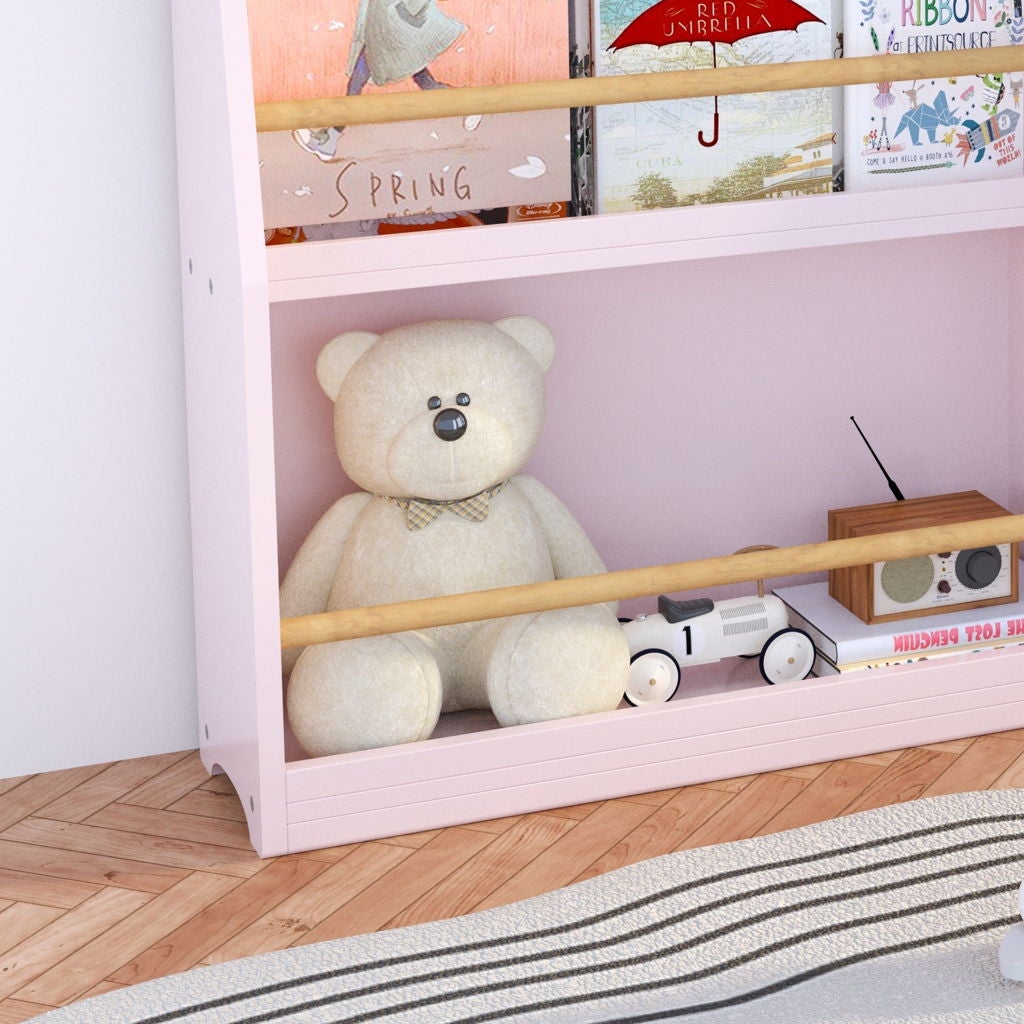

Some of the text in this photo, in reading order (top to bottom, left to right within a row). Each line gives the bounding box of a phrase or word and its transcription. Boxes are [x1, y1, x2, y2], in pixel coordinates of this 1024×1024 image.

[697, 1, 736, 17] RED
[663, 14, 772, 36] UMBRELLA
[907, 30, 997, 54] PRINTSOURCE
[867, 158, 879, 166] COME
[889, 156, 898, 164] SAY
[901, 155, 917, 163] HELLO
[926, 153, 941, 161] BOOTH
[329, 162, 471, 218] SPRING
[682, 625, 692, 656] 1
